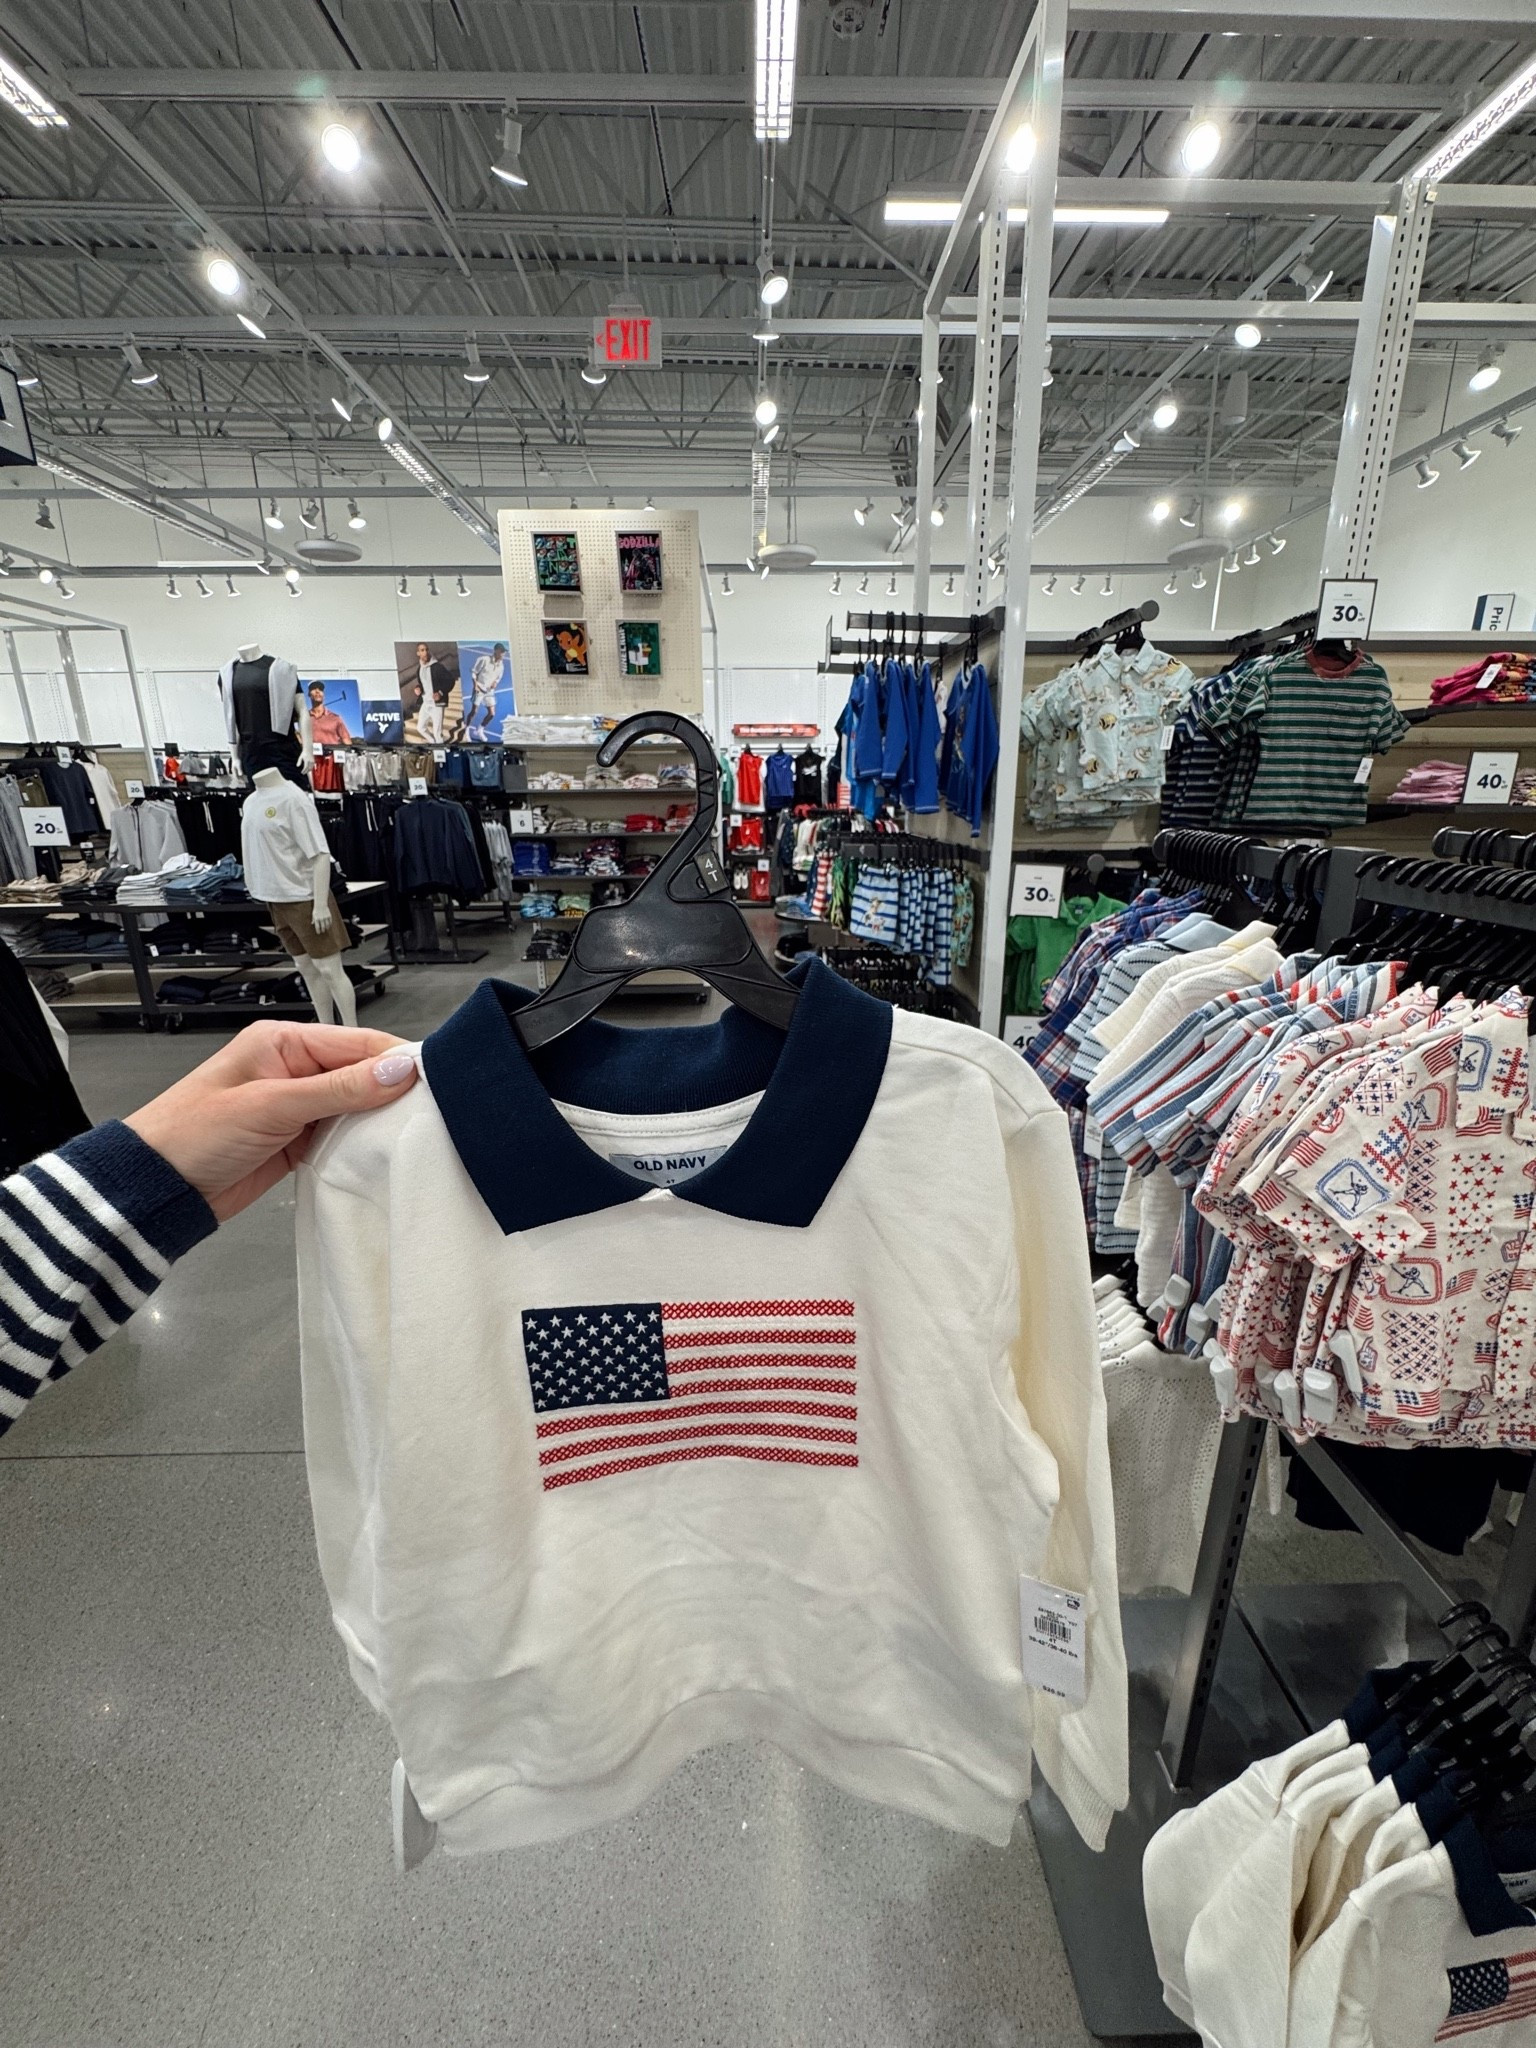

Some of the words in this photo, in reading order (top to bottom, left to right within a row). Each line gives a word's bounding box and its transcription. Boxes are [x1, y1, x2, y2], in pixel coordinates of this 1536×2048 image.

[606, 319, 651, 362] EXIT
[1332, 605, 1359, 622] 30
[365, 712, 400, 722] ACTIVE
[1477, 774, 1502, 789] 40
[34, 823, 56, 834] 20
[1024, 887, 1049, 902] 30
[633, 1160, 663, 1171] OLD
[666, 1156, 706, 1170] NAVY
